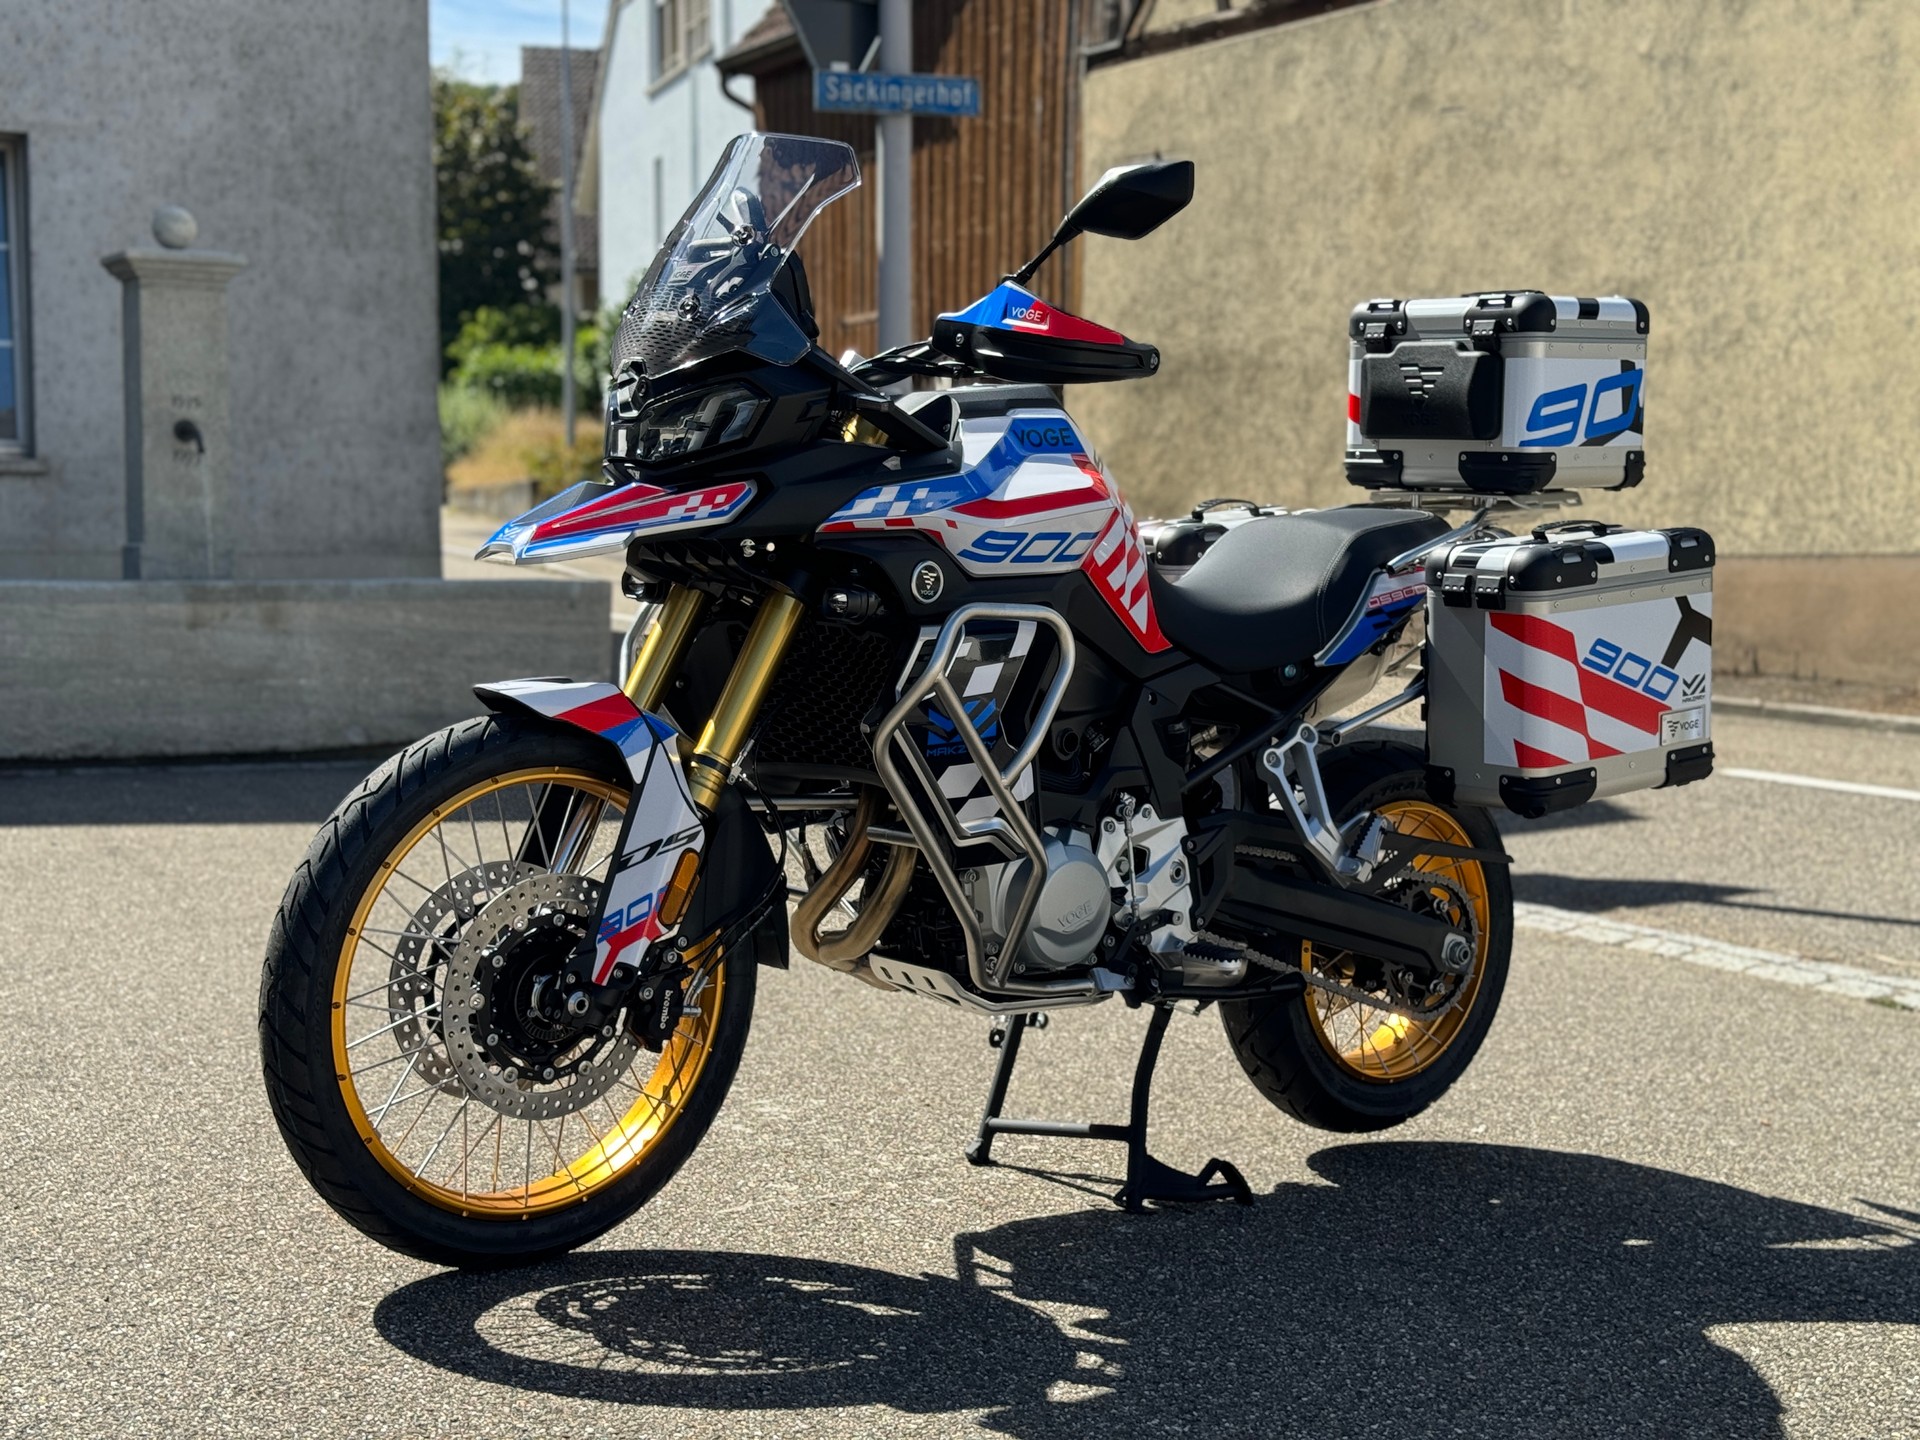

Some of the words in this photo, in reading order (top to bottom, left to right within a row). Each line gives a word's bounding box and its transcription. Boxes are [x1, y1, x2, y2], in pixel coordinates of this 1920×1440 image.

[1012, 307, 1043, 321] VOGE
[1518, 368, 1643, 447] 90
[1012, 427, 1074, 448] VOGE
[956, 530, 1101, 563] 900
[1581, 638, 1680, 701] 900
[1679, 719, 1700, 731] VOGE
[616, 824, 703, 874] DS
[1057, 900, 1092, 928] VOGE
[660, 989, 674, 1030] brembo
